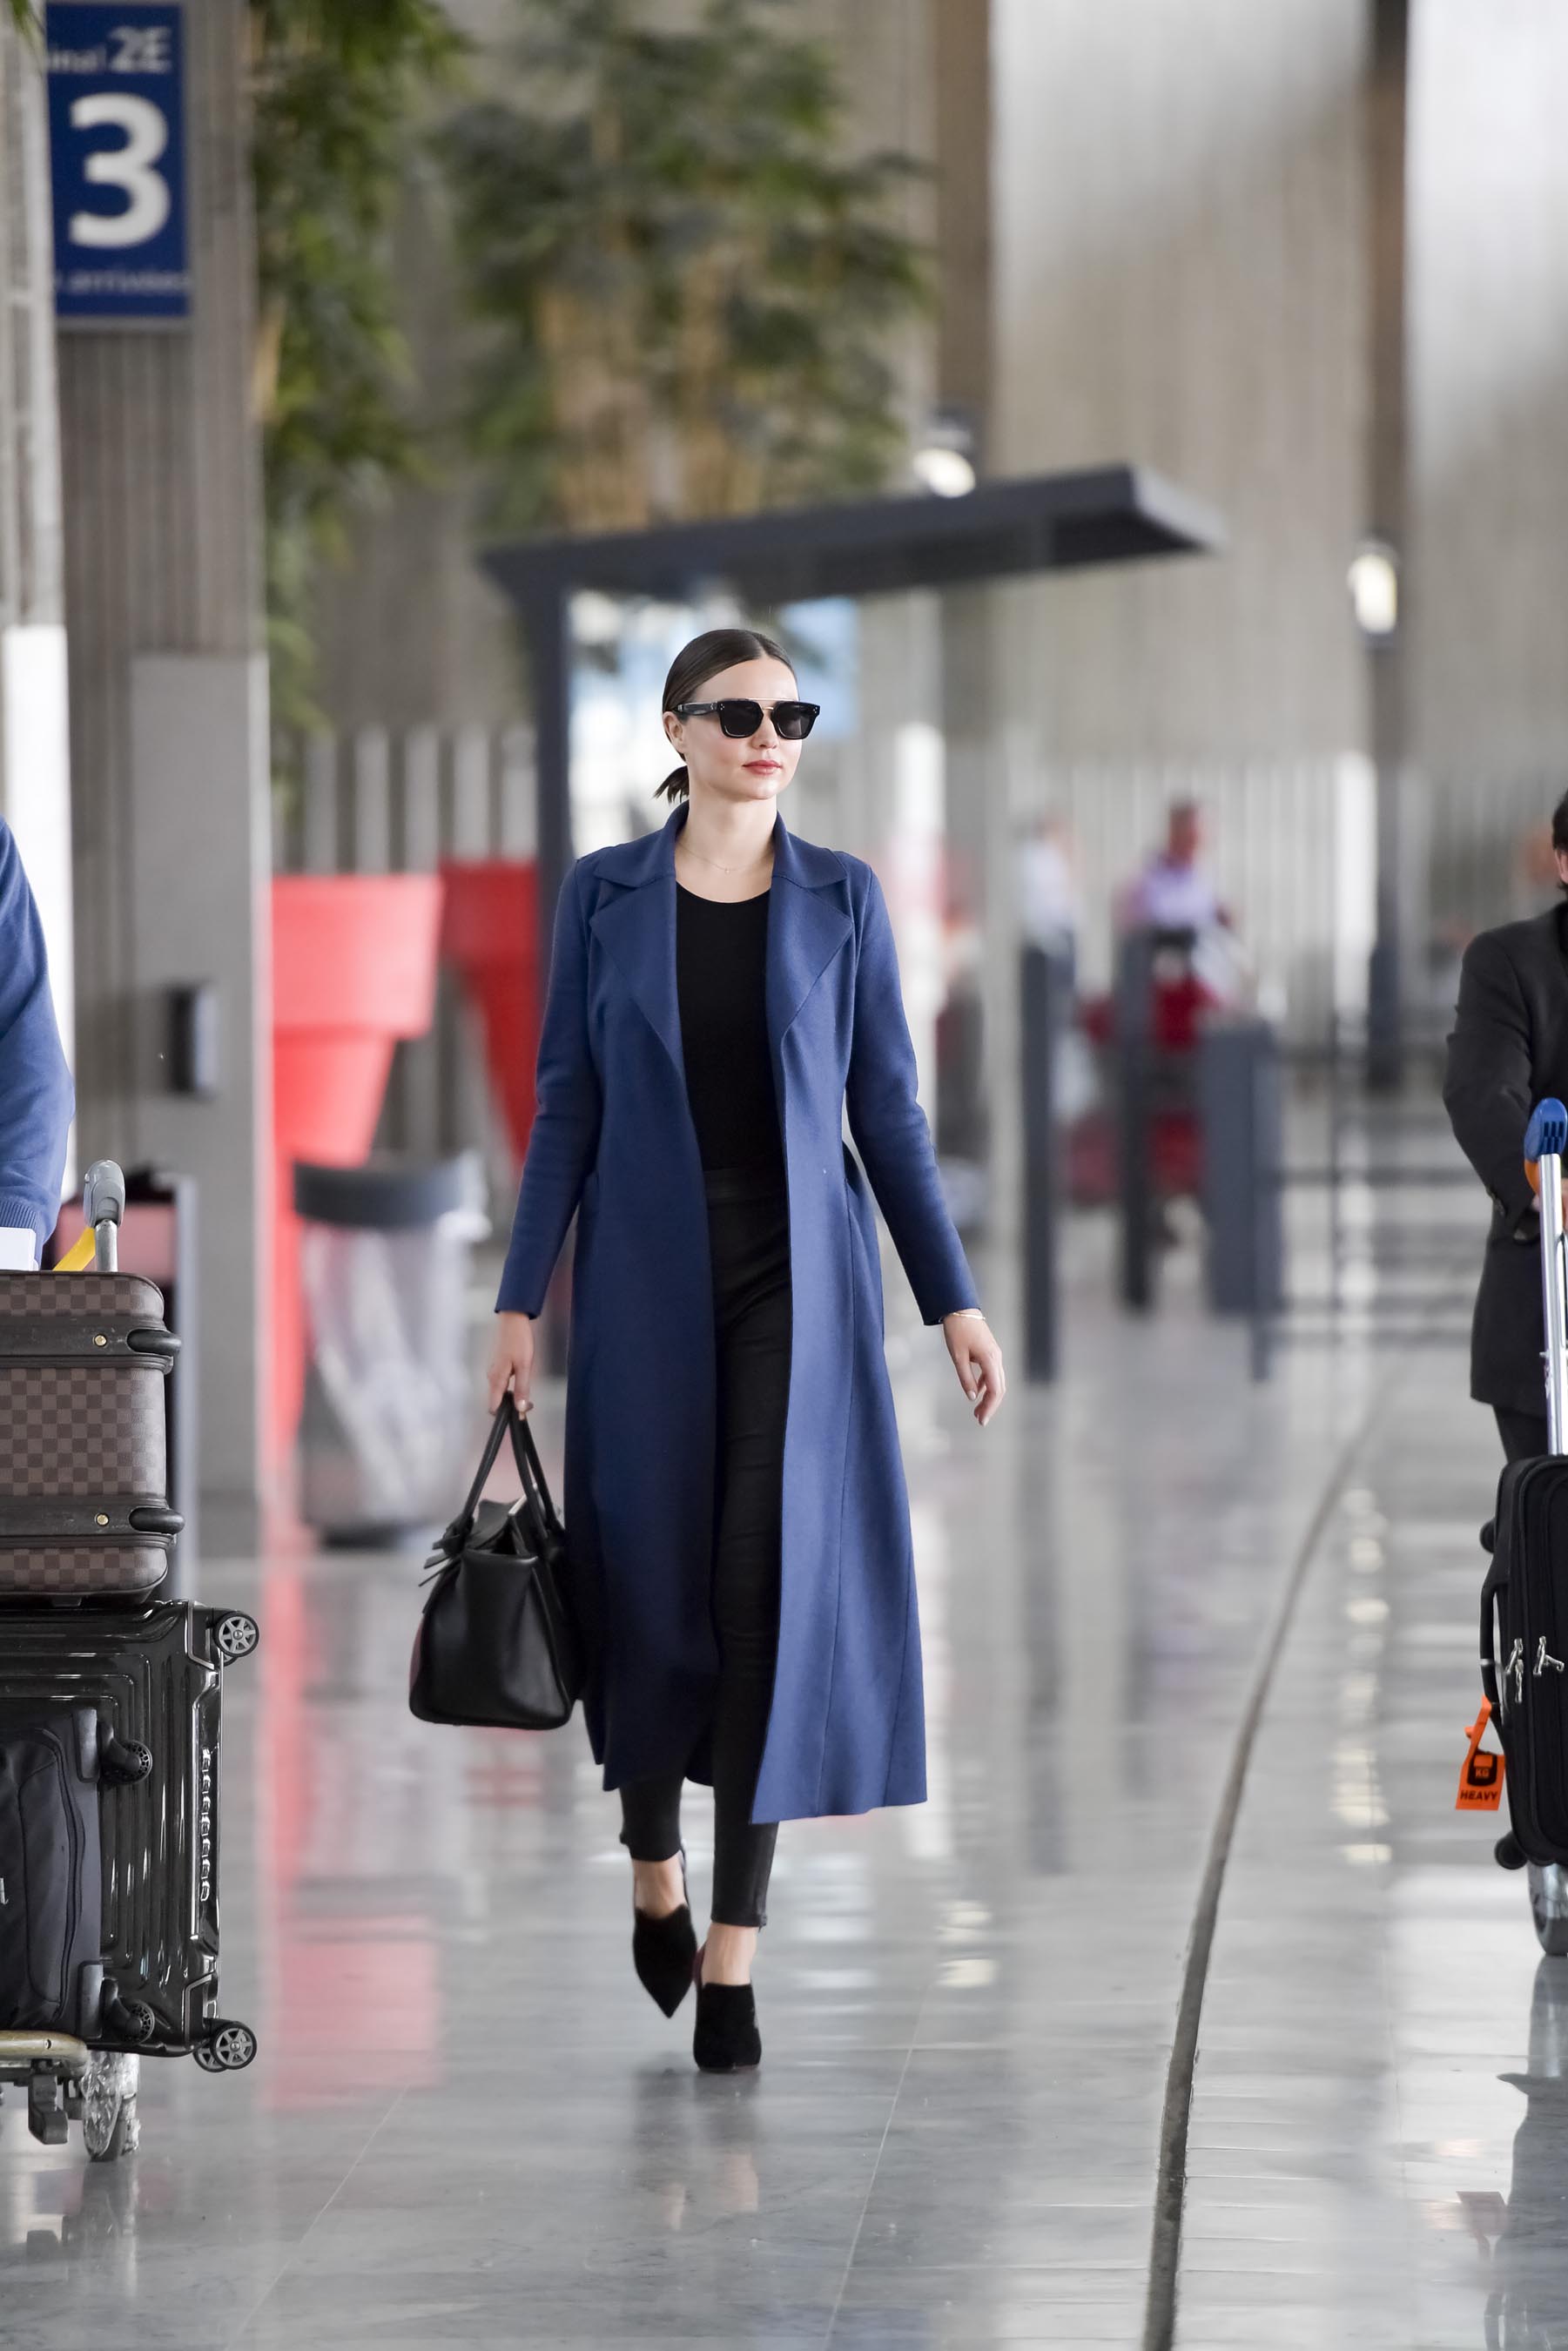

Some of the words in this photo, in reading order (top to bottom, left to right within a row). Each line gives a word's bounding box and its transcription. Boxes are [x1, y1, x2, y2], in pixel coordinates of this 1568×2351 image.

[109, 26, 172, 73] 2E
[69, 92, 171, 248] 3
[1476, 1768, 1489, 1777] KG
[1460, 1790, 1497, 1801] HEAVY
